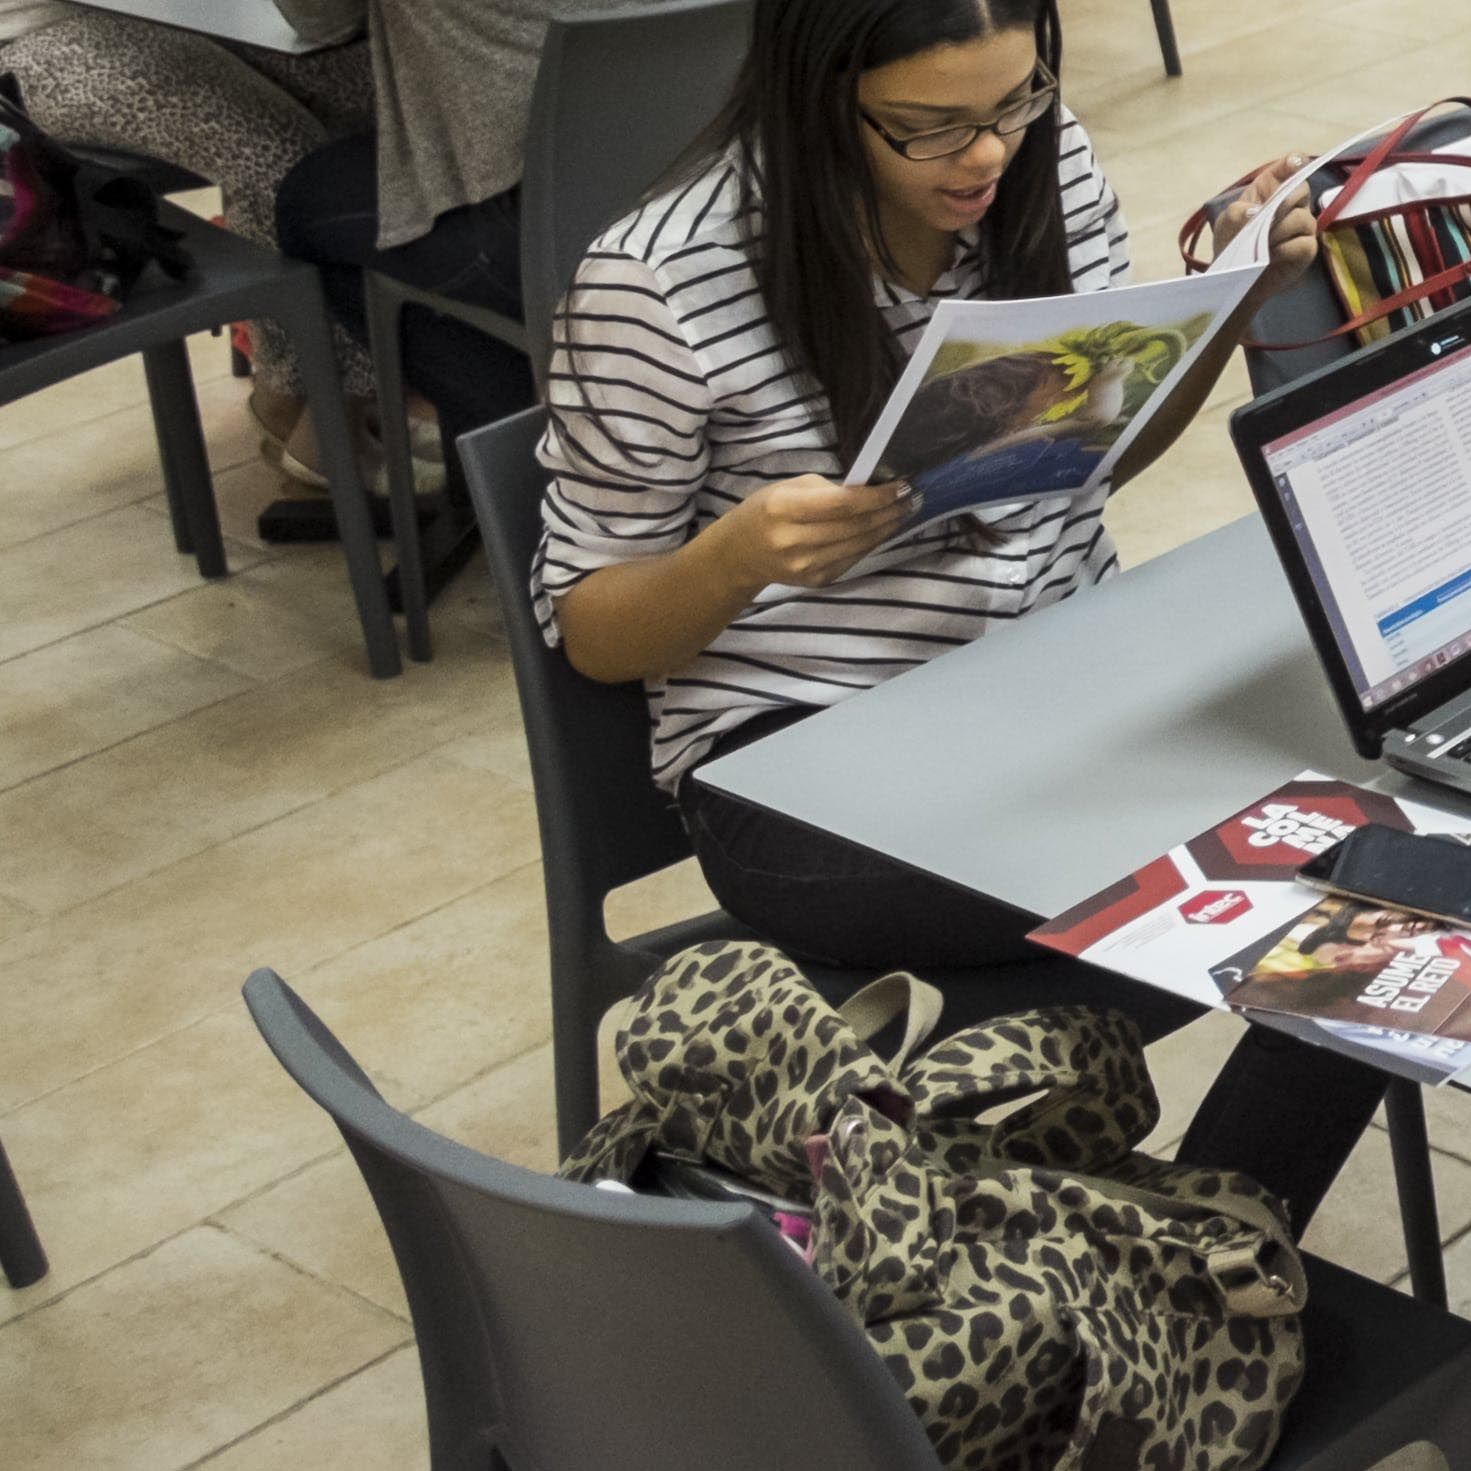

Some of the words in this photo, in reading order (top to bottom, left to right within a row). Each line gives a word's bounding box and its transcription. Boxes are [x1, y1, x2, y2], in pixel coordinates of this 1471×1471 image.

[1357, 951, 1431, 1008] ASUME
[1408, 956, 1461, 992] RETO
[1391, 994, 1431, 1012] EL
